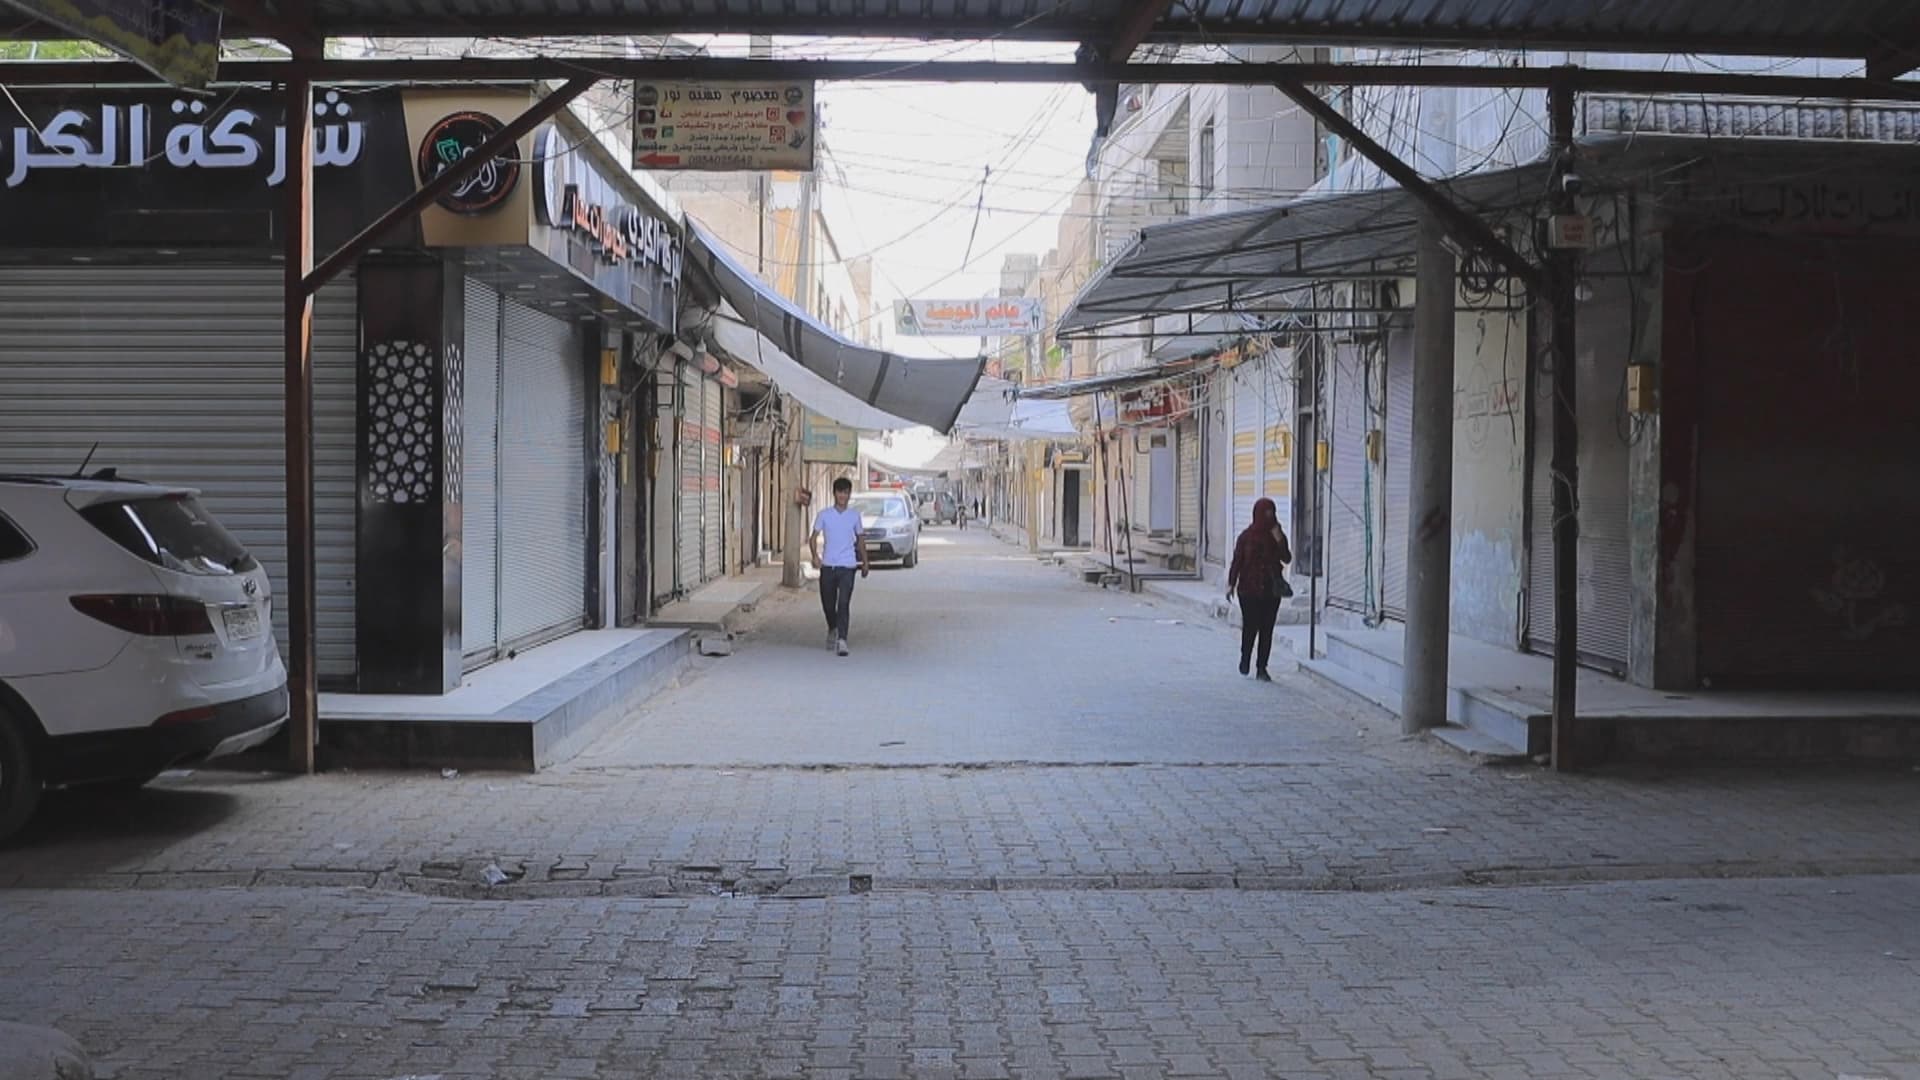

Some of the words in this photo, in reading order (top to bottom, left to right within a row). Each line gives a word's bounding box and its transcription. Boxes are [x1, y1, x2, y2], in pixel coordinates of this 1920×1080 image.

[0, 102, 144, 188] الكر
[166, 90, 362, 188] شركة
[985, 301, 1019, 327] عالم
